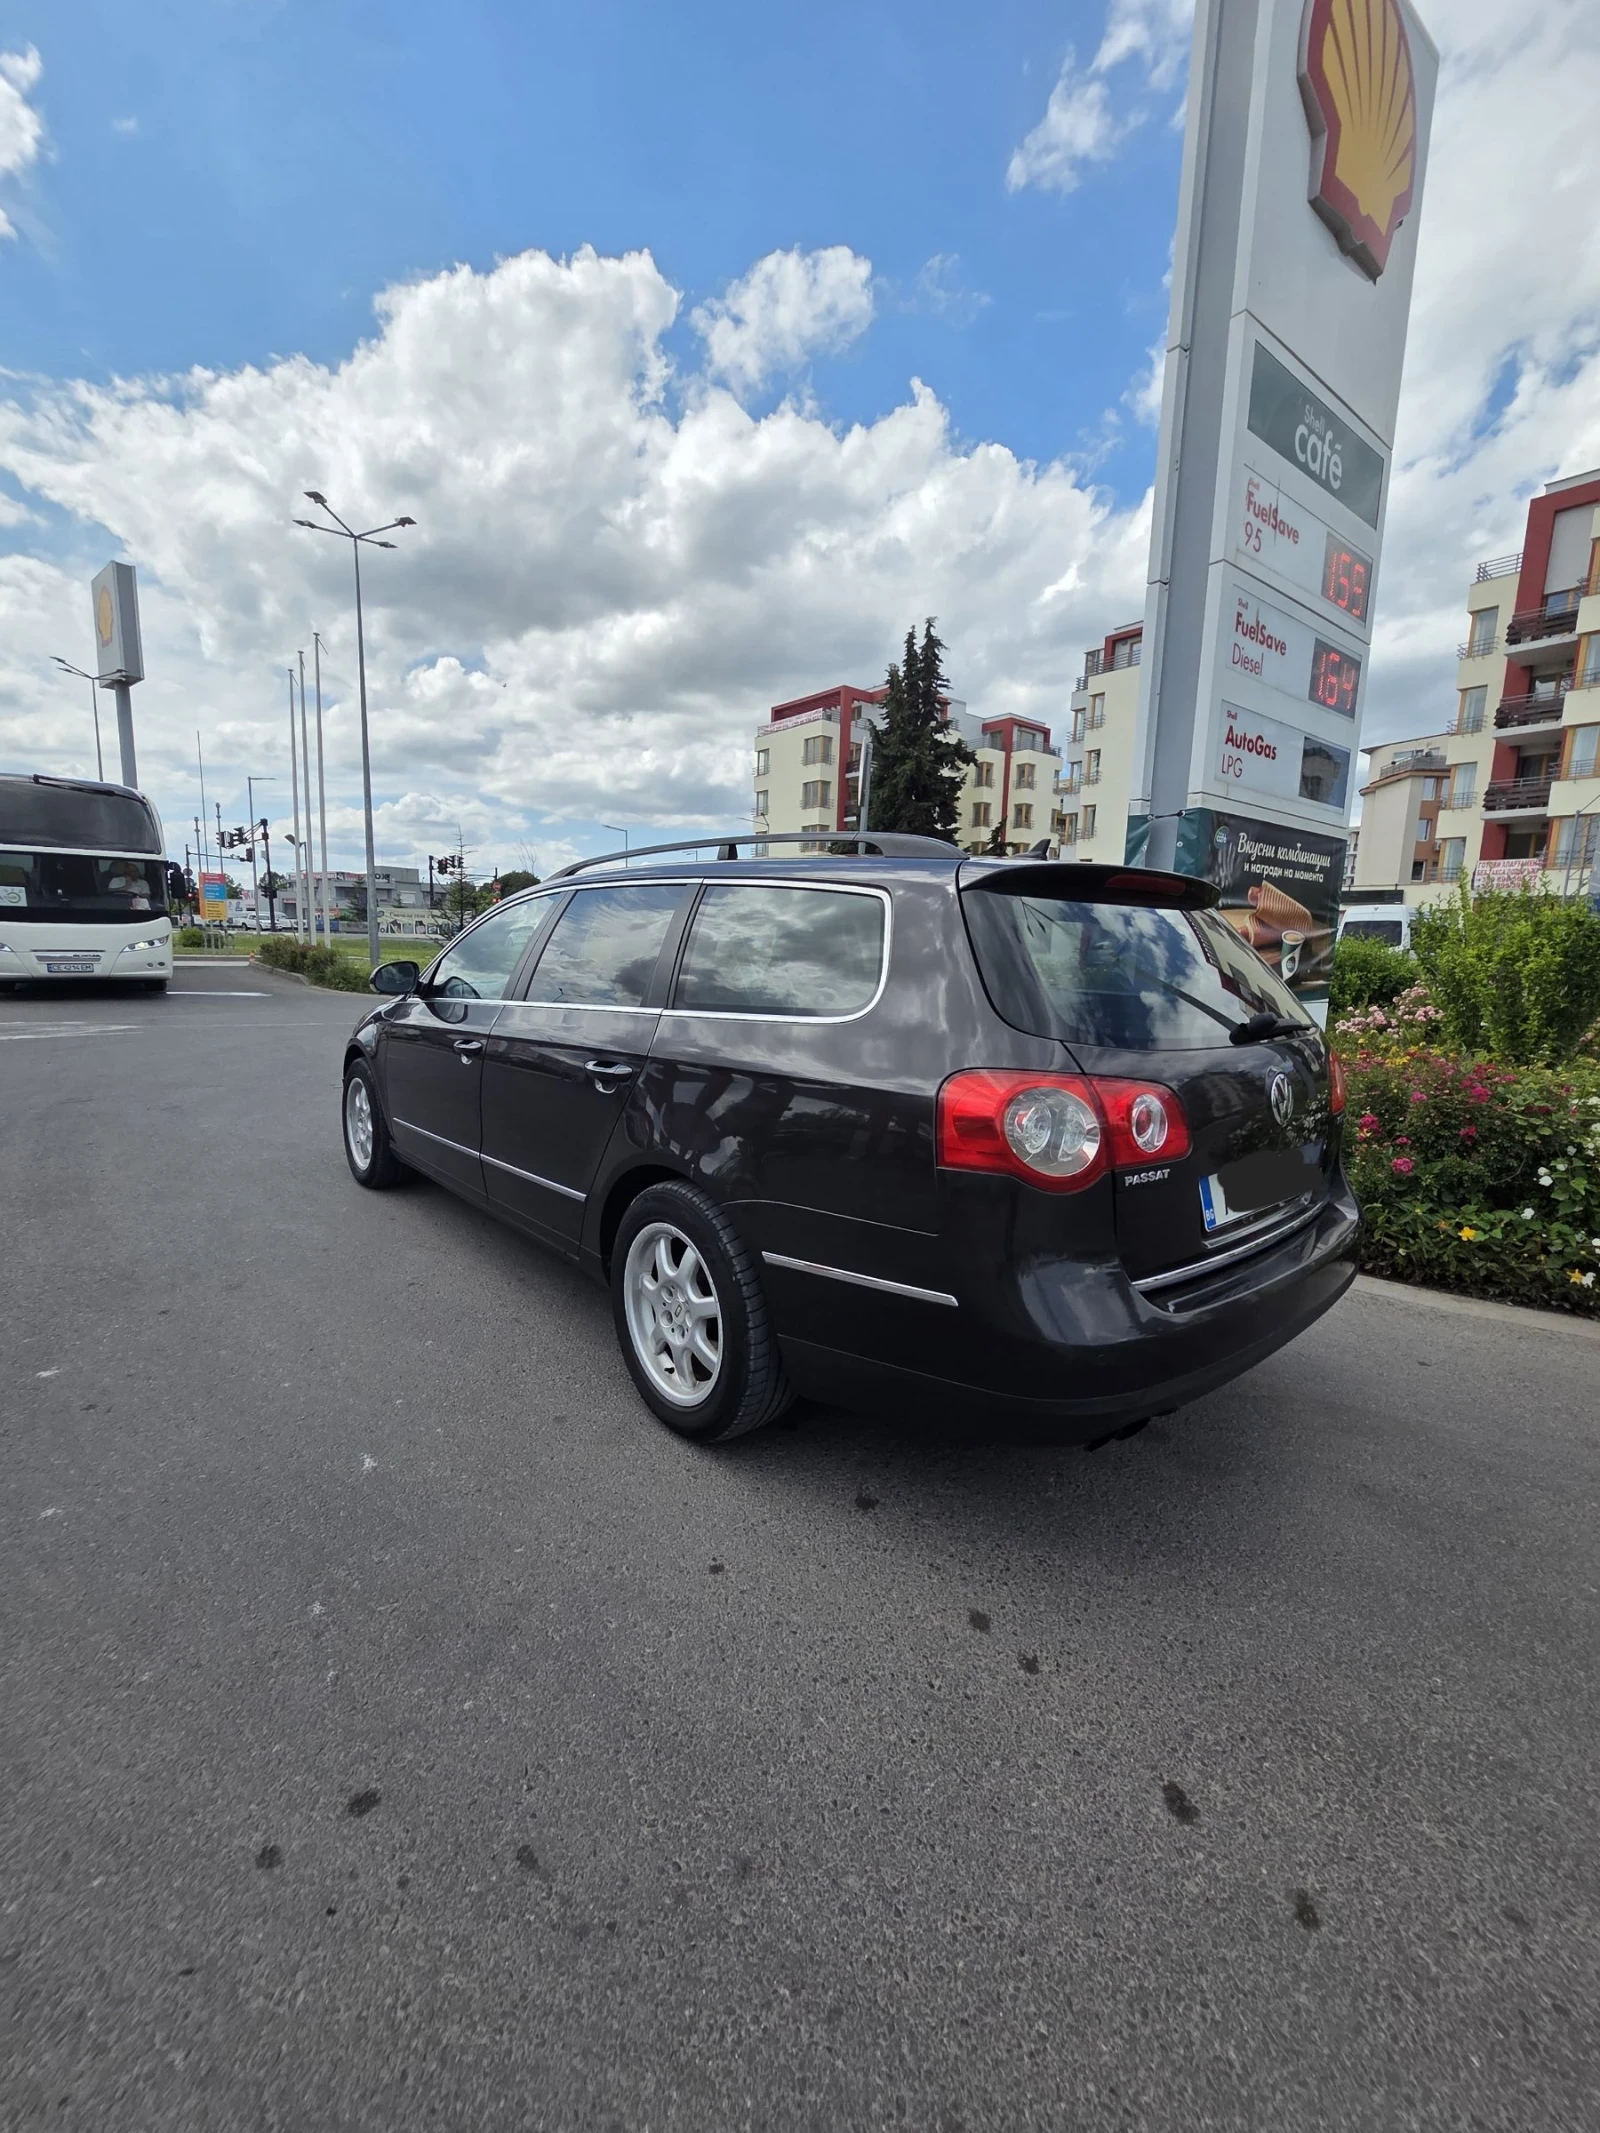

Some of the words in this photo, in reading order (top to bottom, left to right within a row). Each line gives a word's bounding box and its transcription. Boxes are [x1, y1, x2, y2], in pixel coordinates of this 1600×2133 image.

[1304, 404, 1325, 437] Shell
[1295, 424, 1342, 490] café
[1246, 490, 1300, 545] FuelSave
[1245, 521, 1262, 553] 95
[1235, 611, 1287, 656] FuelSave
[1232, 642, 1264, 677] Diesel
[1318, 652, 1355, 710] 164
[1225, 724, 1277, 760] AutoGas
[1221, 753, 1243, 778] LPG
[1237, 832, 1275, 861] Вкусни
[1277, 842, 1331, 871] комбинации
[1244, 861, 1249, 872] и
[1250, 862, 1283, 878] награди
[1284, 868, 1293, 878] на
[1294, 869, 1324, 883] момента
[1124, 1168, 1171, 1187] PASSAT
[1205, 1208, 1215, 1222] BG
